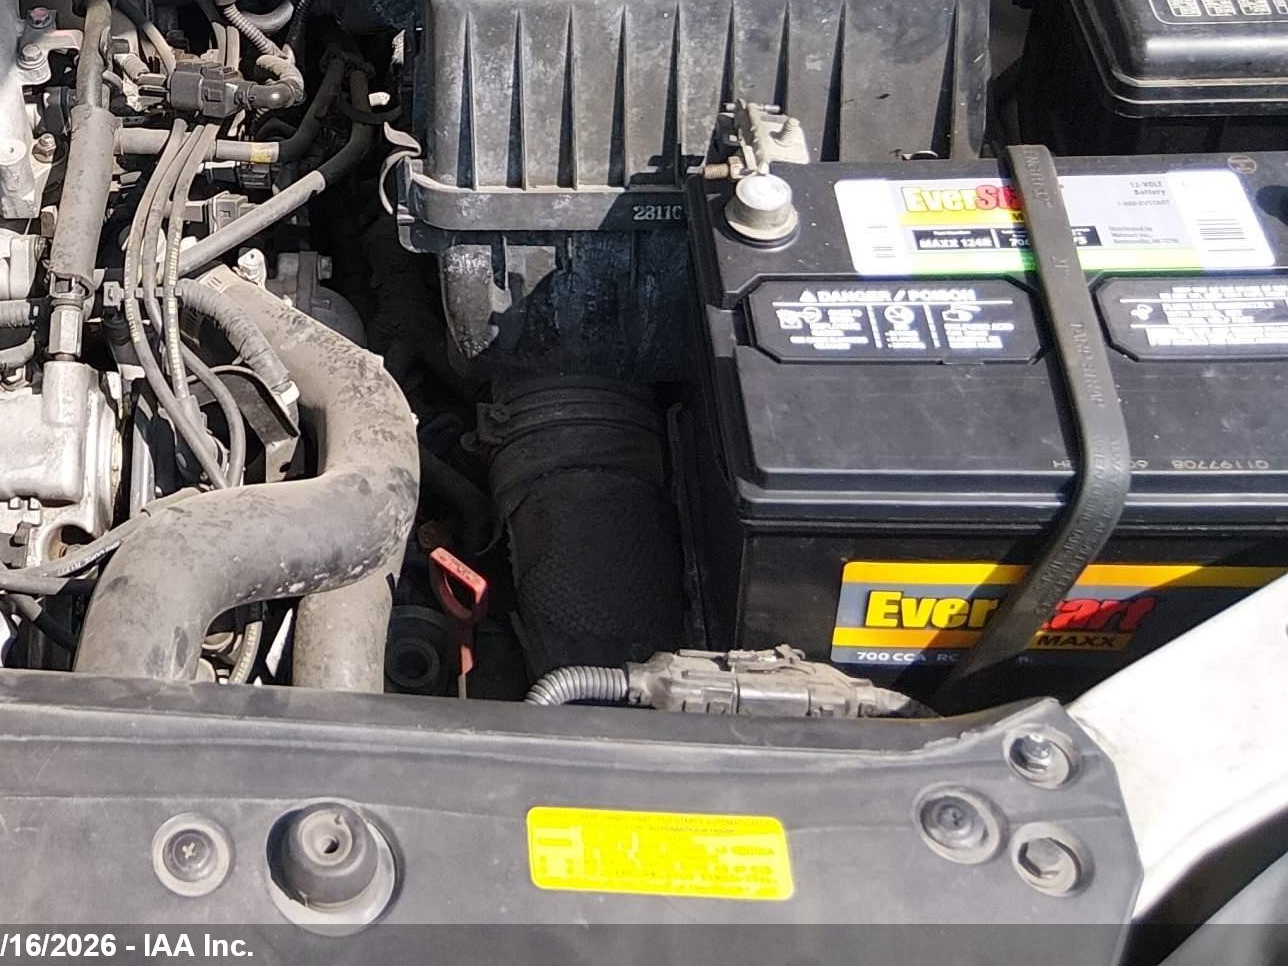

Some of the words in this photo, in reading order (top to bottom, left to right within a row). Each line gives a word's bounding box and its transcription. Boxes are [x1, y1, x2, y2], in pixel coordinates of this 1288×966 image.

[816, 289, 892, 302] DANGER
[908, 288, 977, 301] POISON
[864, 590, 1158, 632] Everart
[1037, 635, 1116, 648] MAXX
[856, 651, 890, 662] 700
[892, 652, 927, 662] CCA
[936, 653, 960, 662] RC
